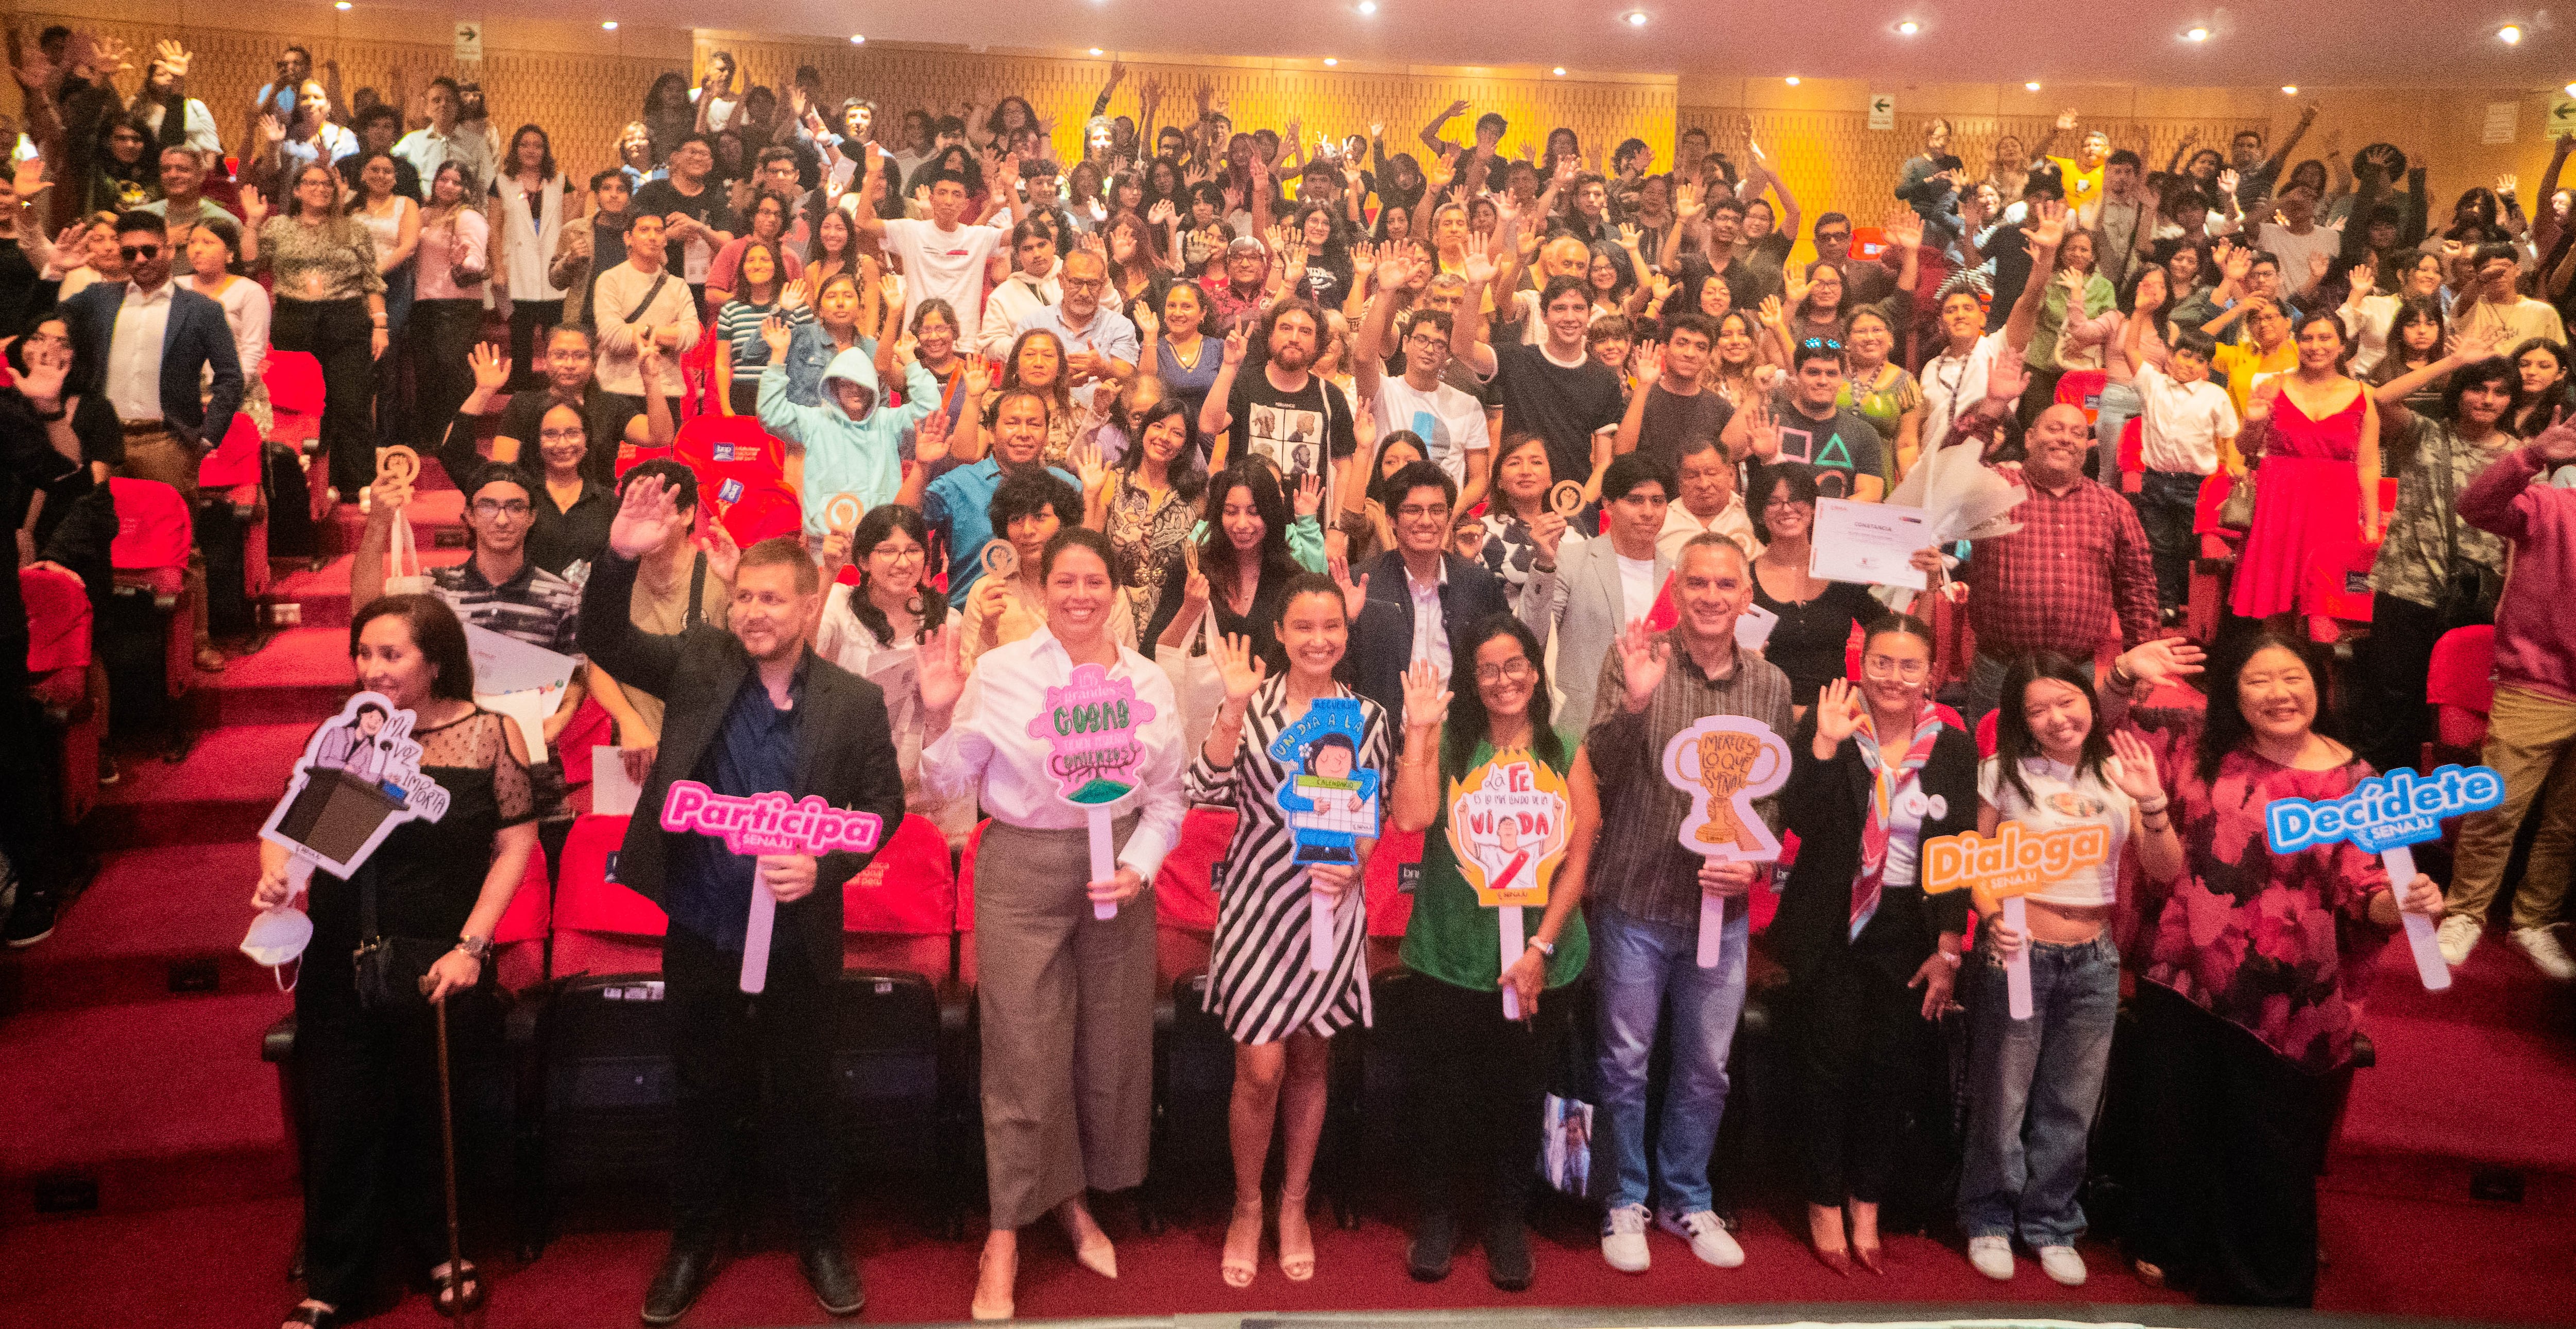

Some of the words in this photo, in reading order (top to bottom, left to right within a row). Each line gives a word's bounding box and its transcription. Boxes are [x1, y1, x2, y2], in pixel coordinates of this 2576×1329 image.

[717, 444, 732, 453] bnp
[1854, 521, 1892, 531] CONSTANCIA
[1275, 734, 1296, 755] UN
[1328, 714, 1336, 727] A
[1344, 715, 1363, 733] LA
[1702, 751, 1719, 769] LO
[1721, 753, 1752, 773] QUE
[1509, 764, 1530, 793] FE
[402, 769, 446, 813] IMPORTA
[1473, 795, 1481, 804] ES
[668, 786, 877, 849] Participa
[2273, 770, 2498, 847] Decídete
[2370, 816, 2433, 840] SENAJU
[742, 833, 793, 849] SENAJU
[1929, 826, 2104, 886] Dialoga
[1403, 867, 1419, 879] bn
[1991, 871, 2037, 890] SENAJU
